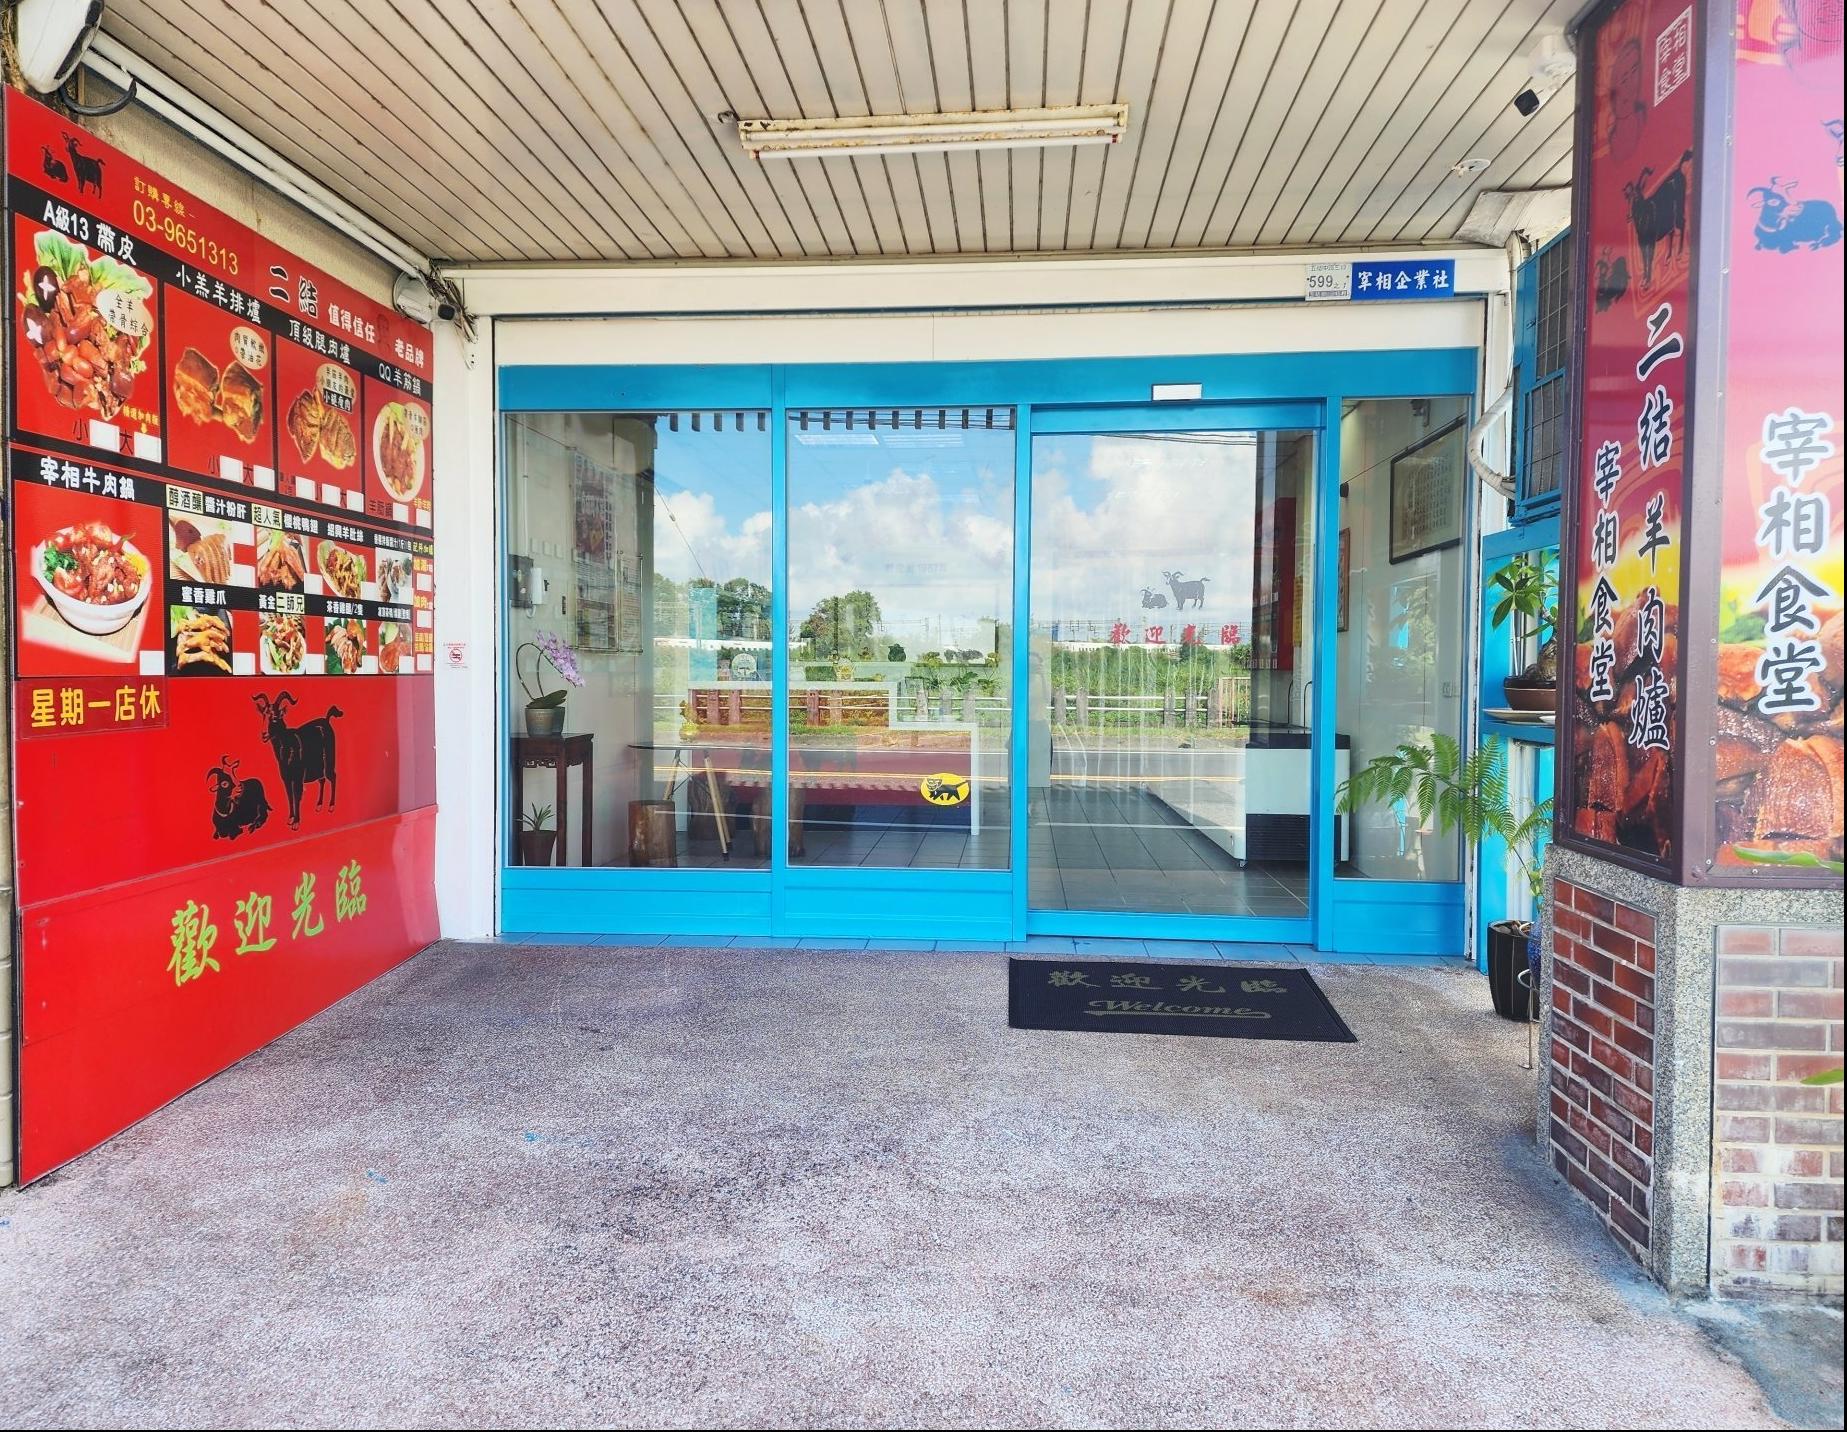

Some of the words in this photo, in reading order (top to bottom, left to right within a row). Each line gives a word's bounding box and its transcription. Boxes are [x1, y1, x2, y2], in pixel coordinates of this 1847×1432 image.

[43, 200, 89, 240] A級13
[96, 222, 136, 265] 帶皮
[133, 200, 238, 275] 03-9651313
[268, 265, 318, 320] 二結
[1357, 269, 1449, 291] 宰相企業社
[115, 294, 134, 316] 全羊
[289, 319, 351, 364] 頂級腿肉爐
[328, 302, 376, 344] 值得信任
[394, 338, 424, 369] 老品牌
[378, 362, 391, 382] QQ
[72, 418, 88, 441] 小
[119, 430, 134, 455] 大
[40, 456, 135, 501] 宰相牛肉鍋
[208, 455, 219, 475] 小
[243, 464, 254, 486] 大
[205, 496, 247, 519] 醬汁粉肝
[253, 506, 281, 527] 超人氣
[1629, 302, 1684, 750] 二結羊肉爐
[1589, 440, 1622, 703] 宰相食堂
[1756, 408, 1836, 715] 宰相食堂
[182, 586, 226, 605] 蜜香雞爪
[1110, 623, 1241, 645] 歡迎光臨
[31, 684, 161, 728] 星期一店休
[167, 859, 367, 987] 歡迎光臨
[1047, 970, 1288, 994] 歡迎光臨
[1088, 1000, 1255, 1016] Welcome
